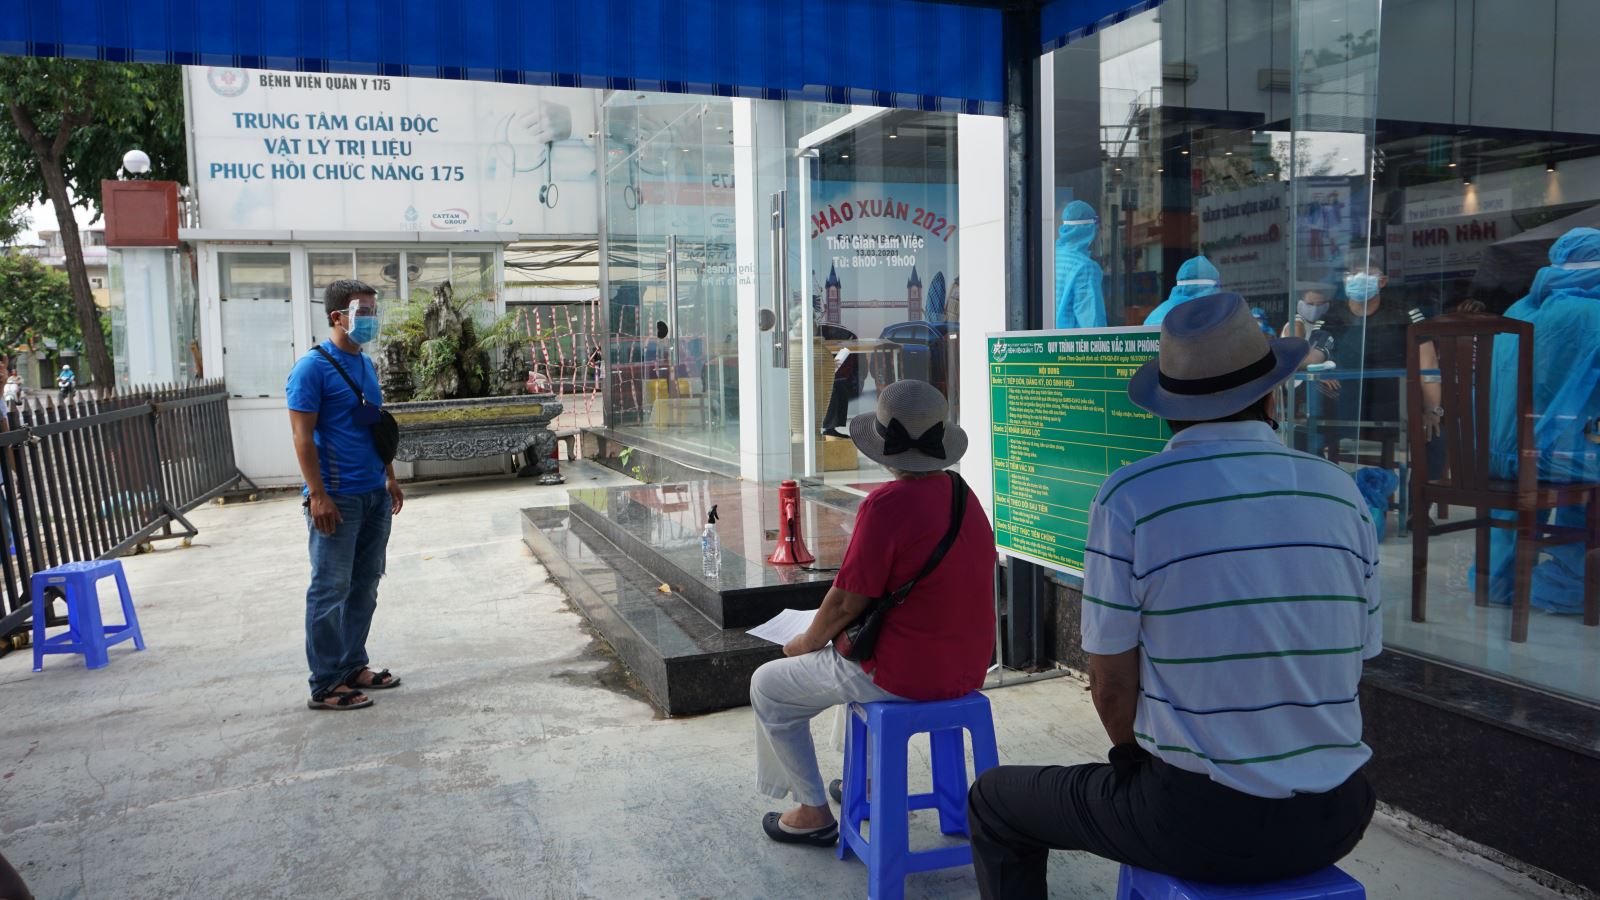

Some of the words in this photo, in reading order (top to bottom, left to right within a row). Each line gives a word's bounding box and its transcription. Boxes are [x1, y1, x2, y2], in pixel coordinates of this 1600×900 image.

[259, 74, 292, 92] BỆNH
[294, 74, 323, 92] VIỆN
[325, 75, 359, 93] QUÂN
[360, 77, 369, 92] Y
[371, 78, 391, 92] 175
[232, 111, 300, 130] TRUNG
[305, 111, 349, 131] TÂM
[354, 112, 394, 132] GIẢI
[400, 114, 439, 135] ĐỘC
[263, 135, 302, 158] VẬT
[307, 136, 330, 156] LÝ
[336, 139, 366, 159] TRỊ
[371, 138, 413, 160] LIỆU
[209, 163, 265, 183] PHỤC
[271, 158, 306, 180] HỒI
[312, 161, 366, 181] CHỨC
[370, 161, 424, 182] NĂNG
[430, 165, 465, 182] 175
[857, 197, 909, 221] XUÂN
[912, 207, 957, 242] 2021
[827, 235, 850, 250] Thời
[852, 236, 875, 249] Gian
[878, 235, 899, 249] Làm
[902, 234, 924, 252] Việc
[852, 255, 876, 267] 8h00
[886, 255, 916, 267] 19h00
[1047, 341, 1058, 354] QUY
[1059, 339, 1074, 353] TRÌNH
[1075, 339, 1089, 353] TIÊM
[1090, 337, 1110, 353] CHỦNG
[1111, 335, 1123, 352] VẮC
[1124, 340, 1136, 352] XIN
[1137, 337, 1160, 352] PHÒNG
